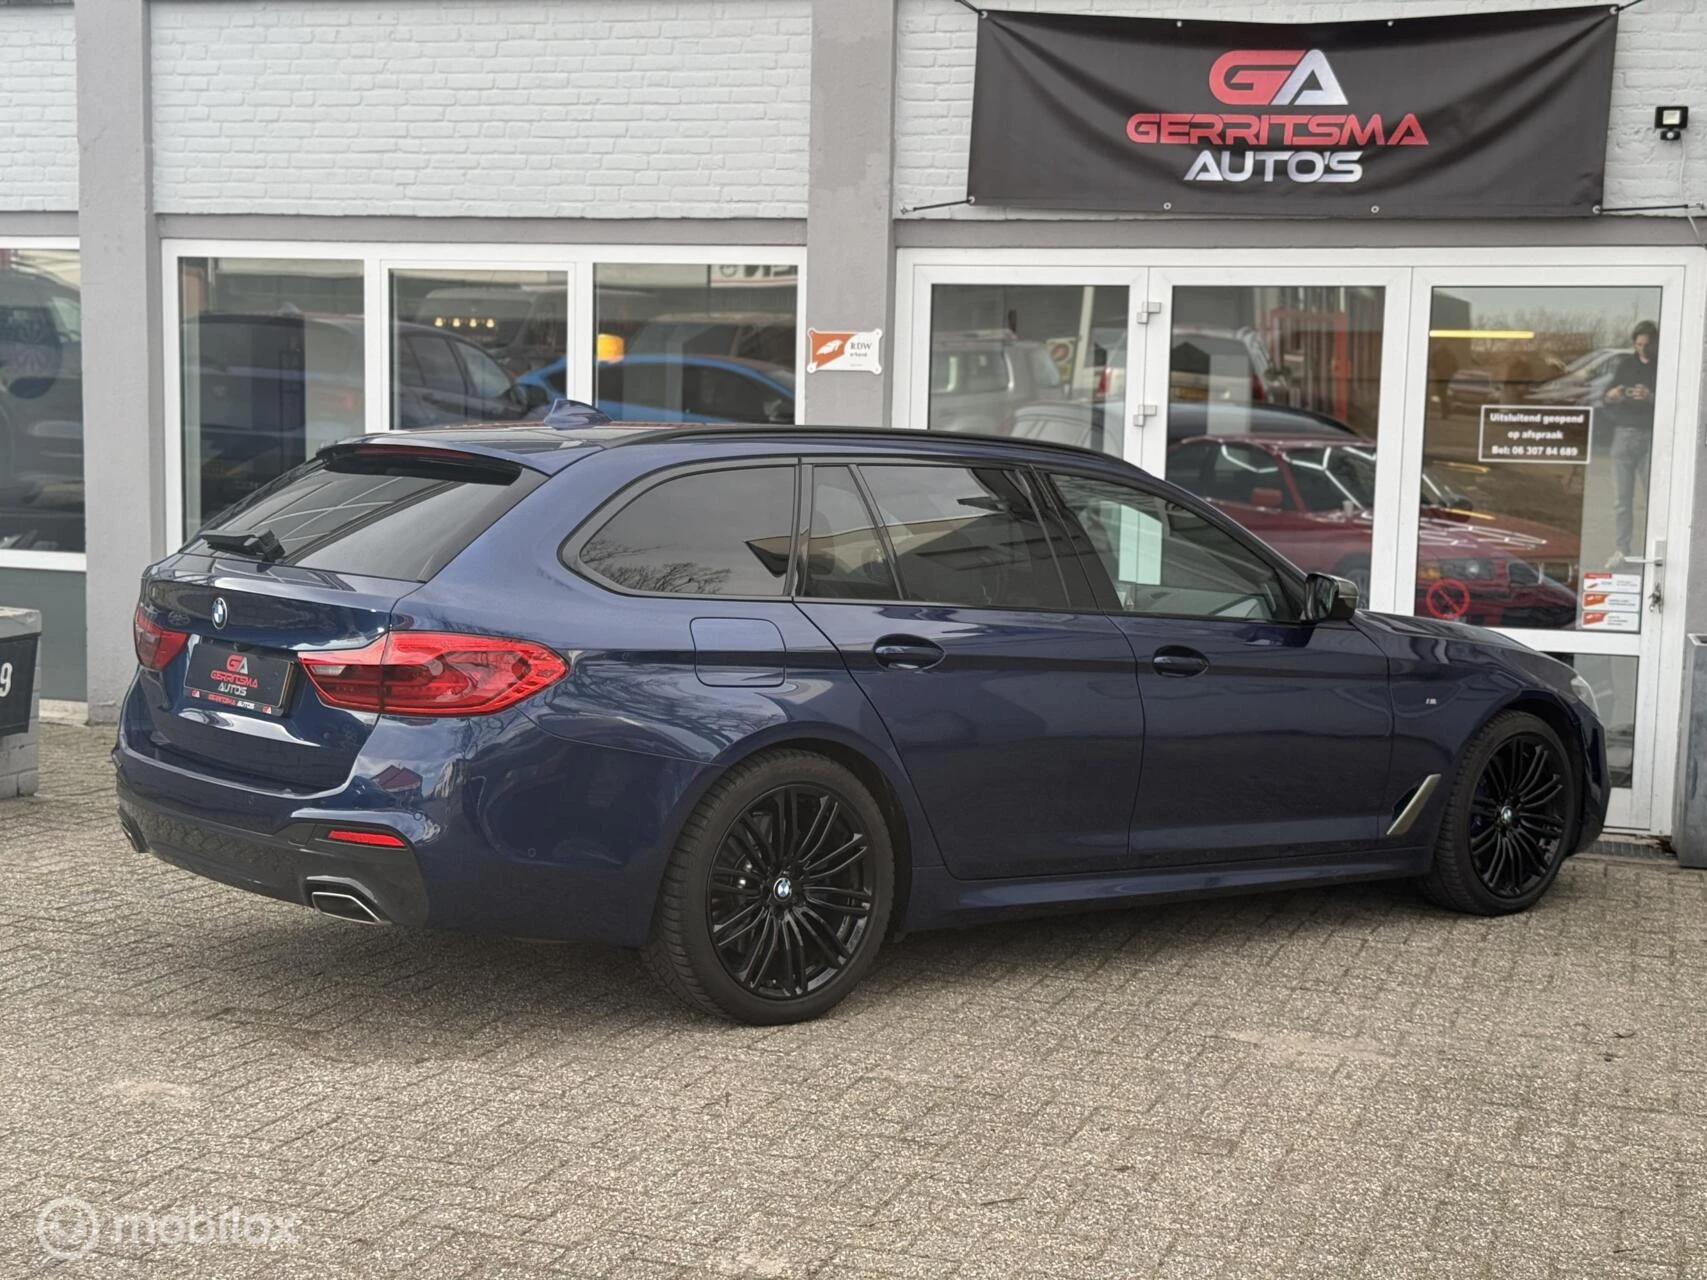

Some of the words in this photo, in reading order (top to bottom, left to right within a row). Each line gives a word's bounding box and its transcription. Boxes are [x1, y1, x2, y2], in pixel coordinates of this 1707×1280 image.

[1208, 49, 1349, 106] GA
[1126, 112, 1429, 146] GERRITSMA
[1184, 150, 1363, 183] AUTO'S
[850, 342, 872, 350] RDW
[1490, 413, 1541, 423] Uitsluitend
[1543, 414, 1584, 424] geopend
[1507, 431, 1520, 440] op
[1522, 430, 1563, 440] afspraak
[0, 662, 13, 697] 9
